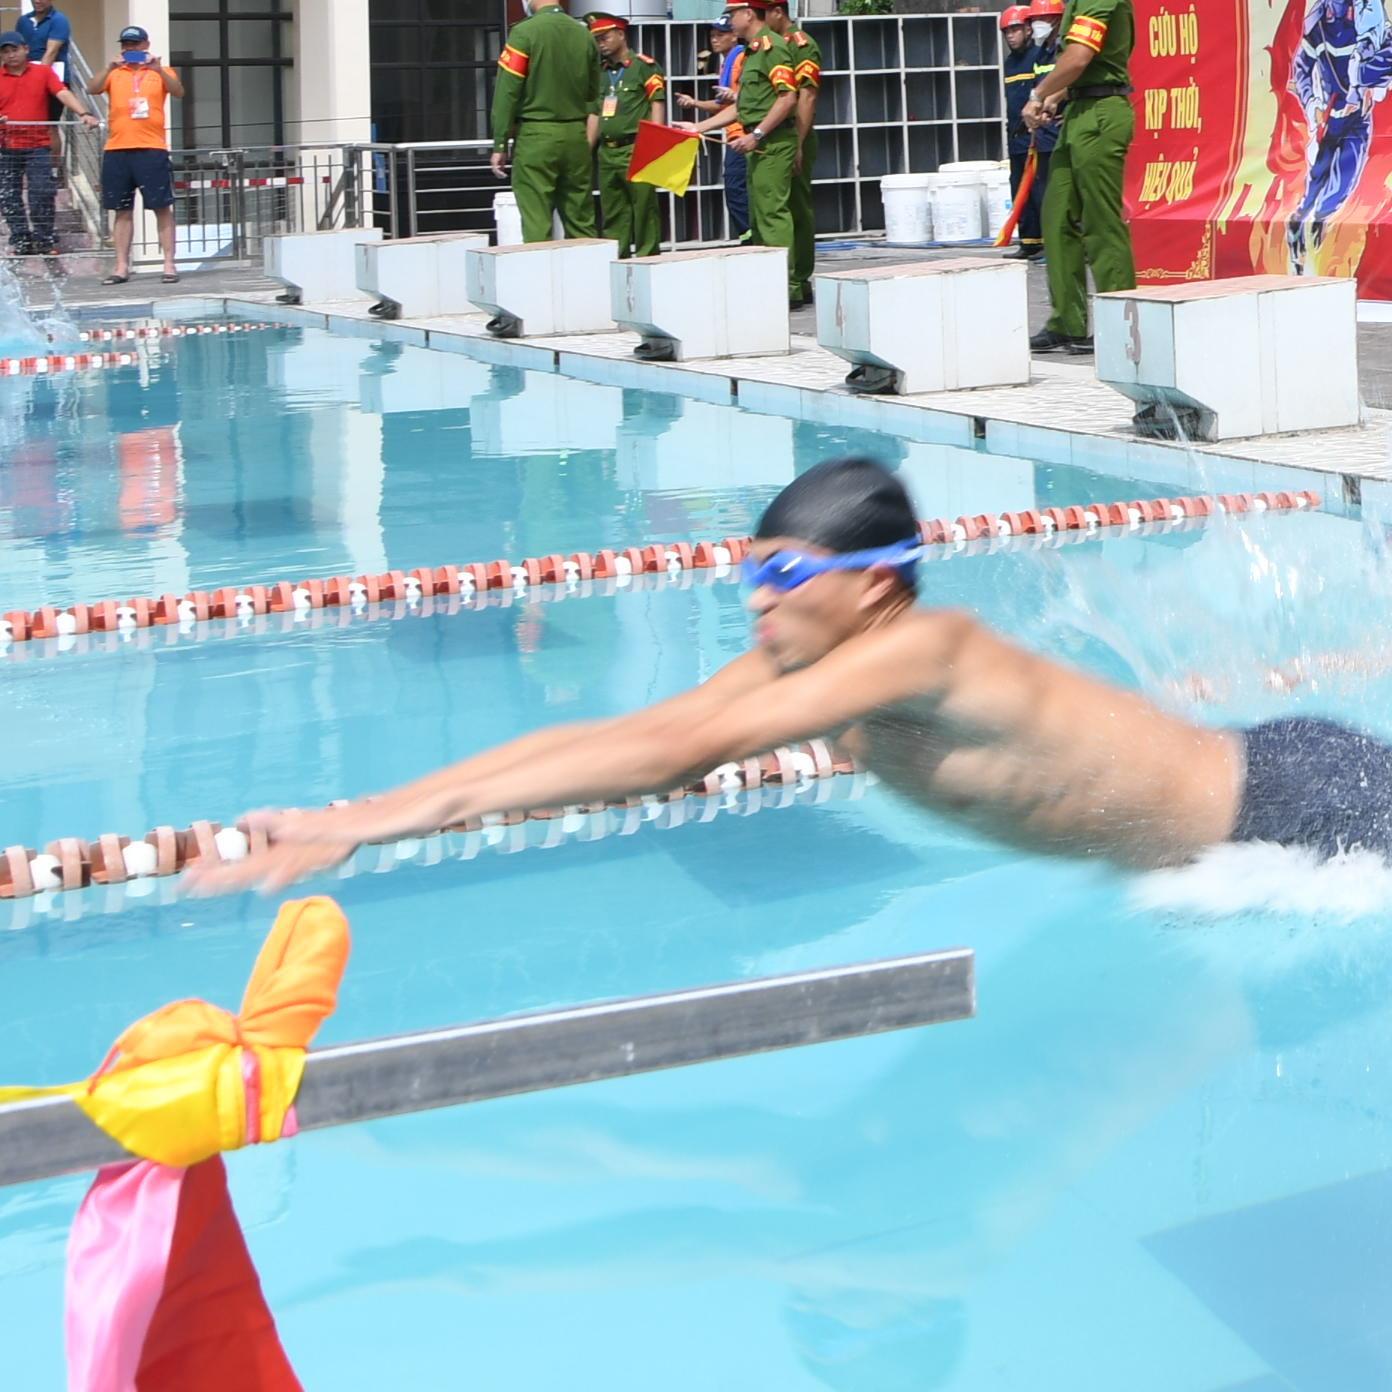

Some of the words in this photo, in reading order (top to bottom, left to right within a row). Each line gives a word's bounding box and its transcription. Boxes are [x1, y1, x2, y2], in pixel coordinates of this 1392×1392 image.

[1149, 6, 1177, 58] CỨU
[1179, 3, 1199, 64] HỘ
[1145, 88, 1168, 139] KỊP
[1170, 76, 1202, 134] THỜI,
[1138, 153, 1172, 210] HIỆU
[1166, 146, 1199, 205] QUẢ
[1123, 299, 1142, 364] 3
